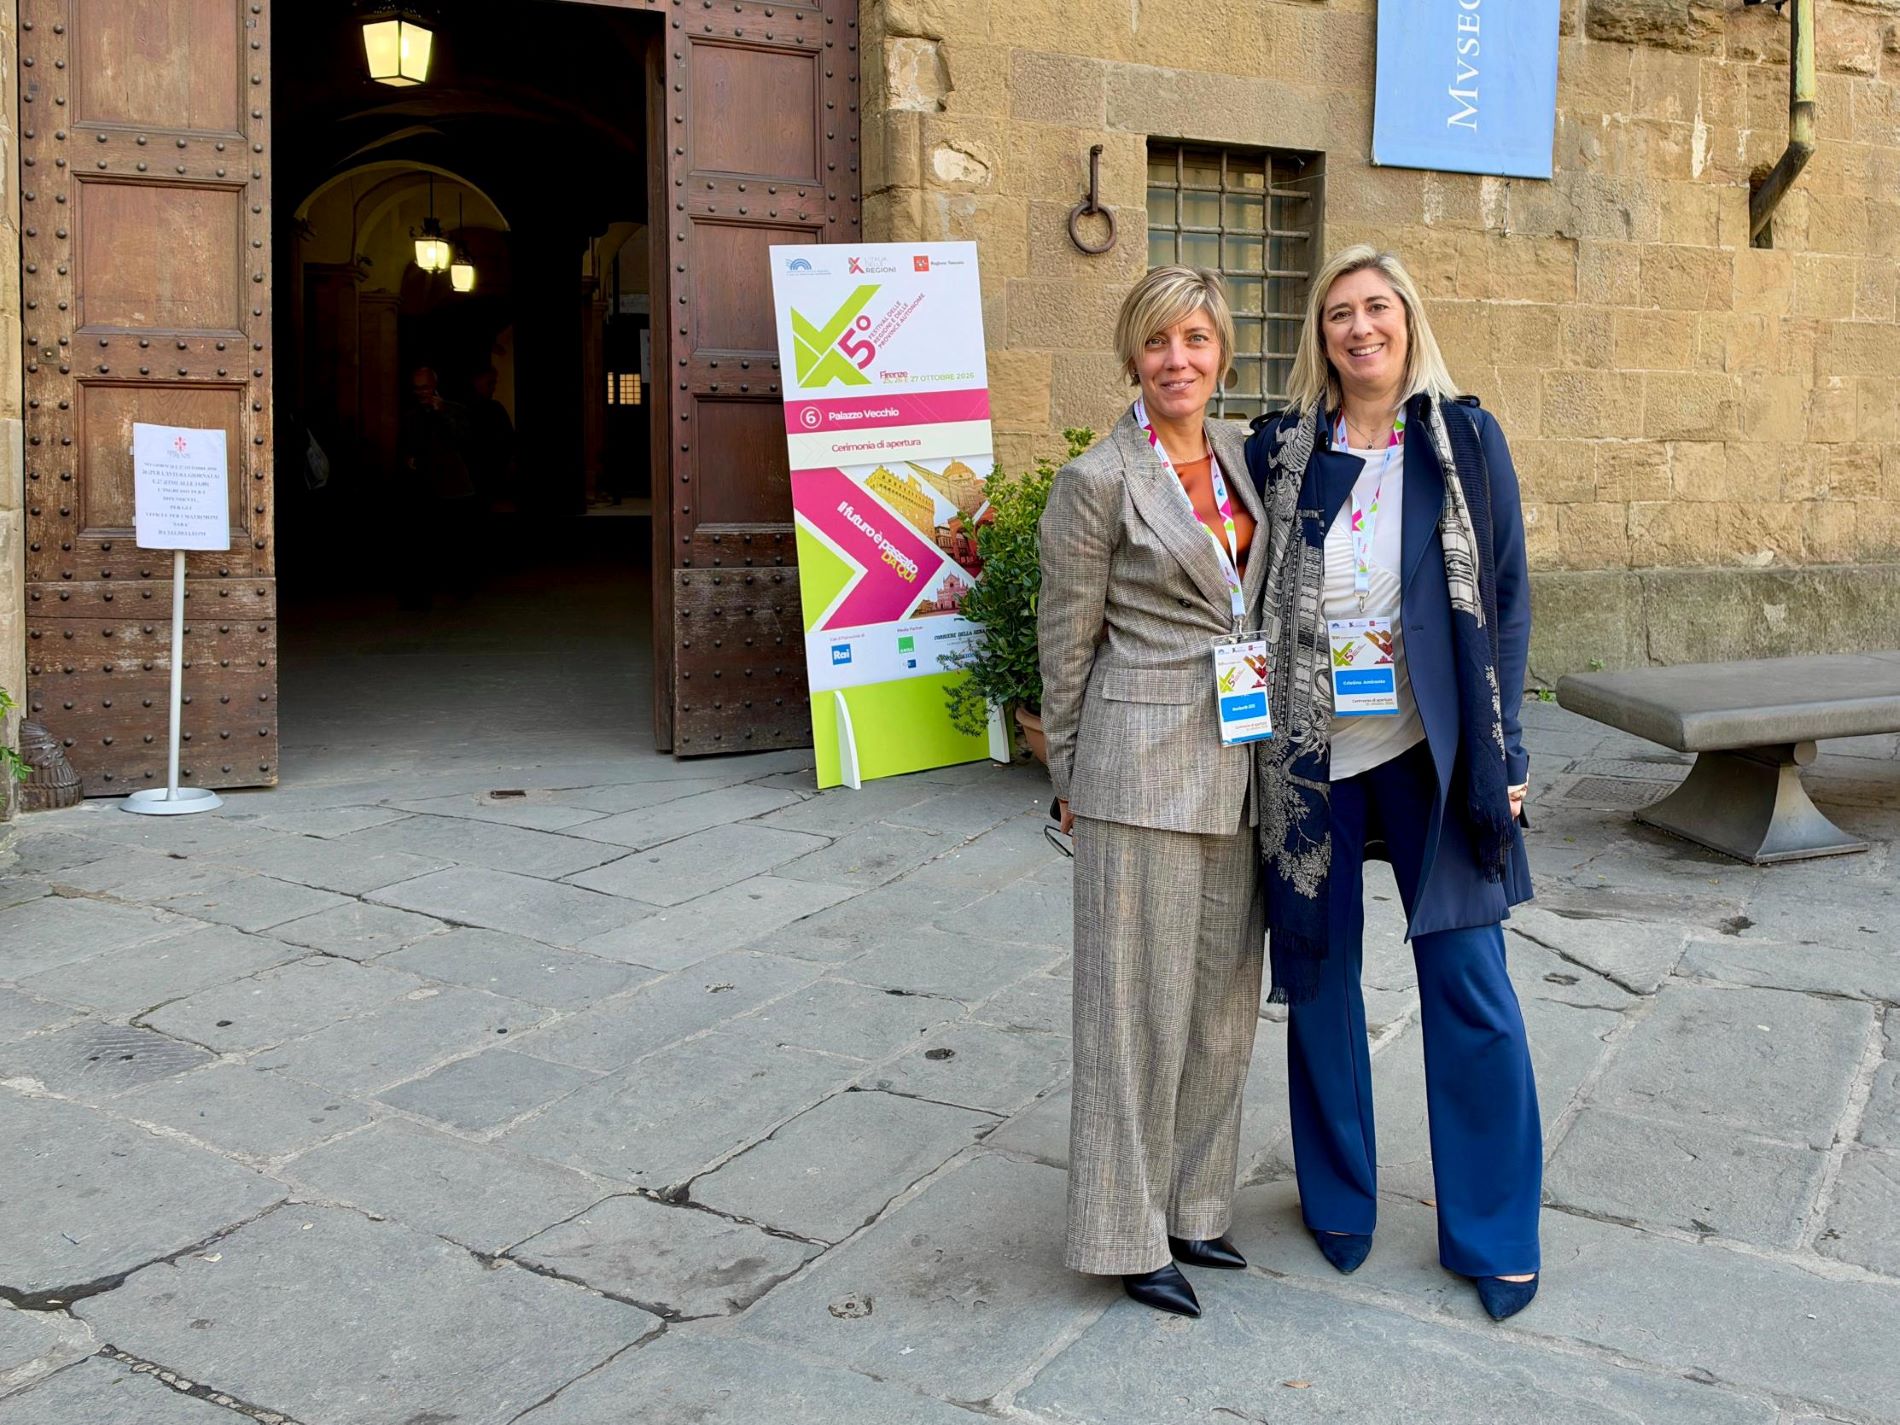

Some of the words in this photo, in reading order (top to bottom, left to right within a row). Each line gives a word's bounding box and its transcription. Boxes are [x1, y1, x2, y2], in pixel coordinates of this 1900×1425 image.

[865, 266, 897, 274] REGIONI
[868, 316, 889, 340] FESTIVAL
[887, 300, 902, 318] DELLE
[873, 321, 893, 345] REGIONI
[894, 302, 909, 319] DELLE
[878, 323, 901, 349] PROVINCE
[900, 293, 926, 324] AUTONOME
[880, 370, 908, 379] Firenze
[910, 375, 919, 383] 27
[920, 373, 955, 381] OTTOBRE
[805, 410, 817, 424] 6
[828, 409, 864, 421] Palazzo
[865, 406, 900, 418] Vecchio
[832, 441, 876, 453] Cerimonia
[877, 439, 885, 449] di
[886, 438, 922, 450] apertura
[837, 500, 848, 513] Il
[843, 506, 876, 538] futuro
[873, 530, 883, 544] è
[878, 538, 918, 574] passato
[881, 551, 897, 569] DA
[897, 563, 917, 583] QUI
[934, 632, 957, 641] CORRIERE
[957, 630, 973, 638] DELLA
[833, 648, 850, 661] Rai
